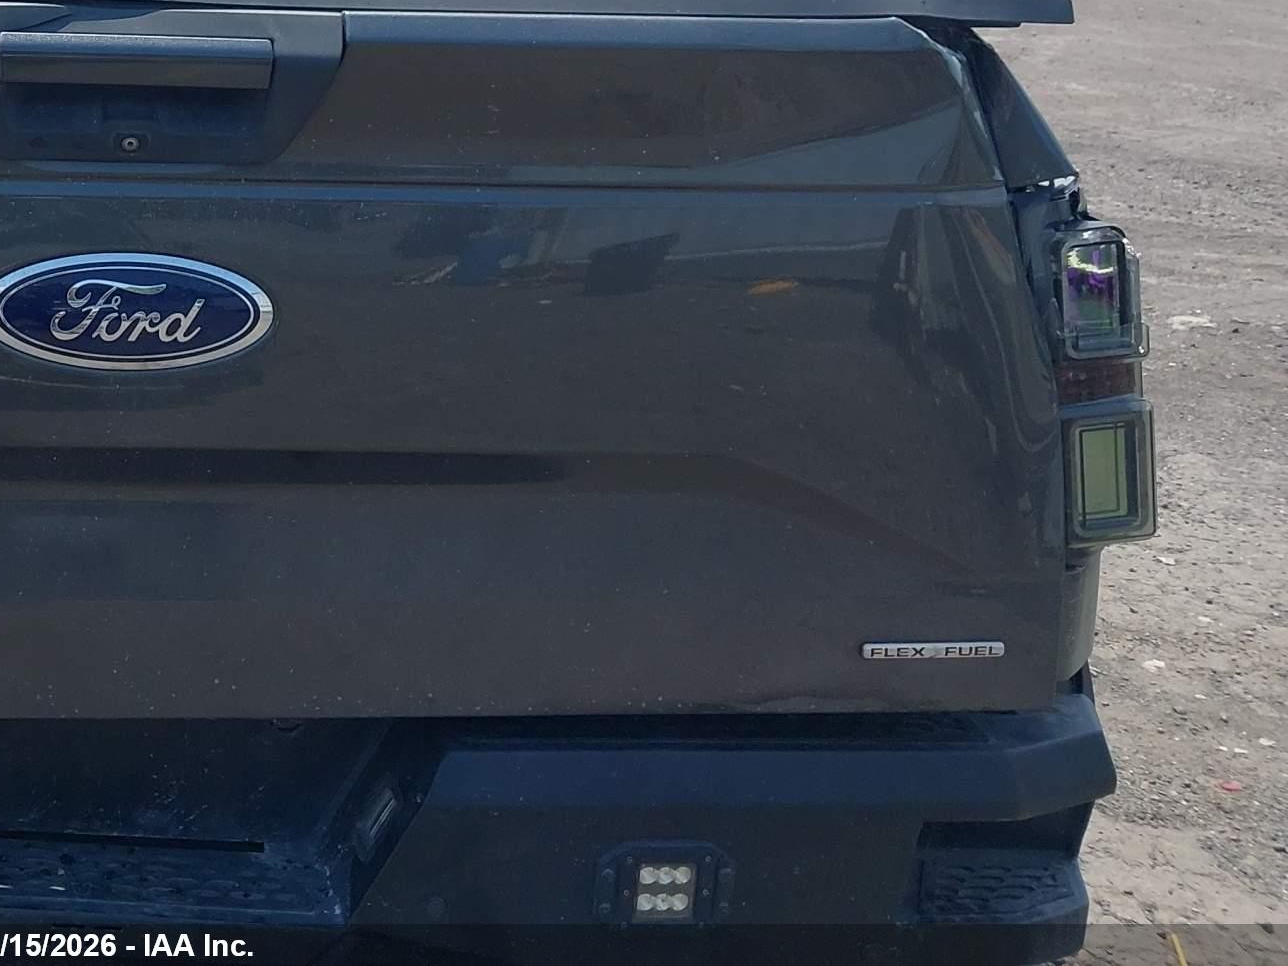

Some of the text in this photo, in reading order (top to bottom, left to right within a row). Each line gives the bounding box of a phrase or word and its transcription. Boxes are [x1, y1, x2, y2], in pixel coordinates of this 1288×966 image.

[50, 279, 206, 342] Ford
[870, 645, 1000, 658] FLEX FUEL
